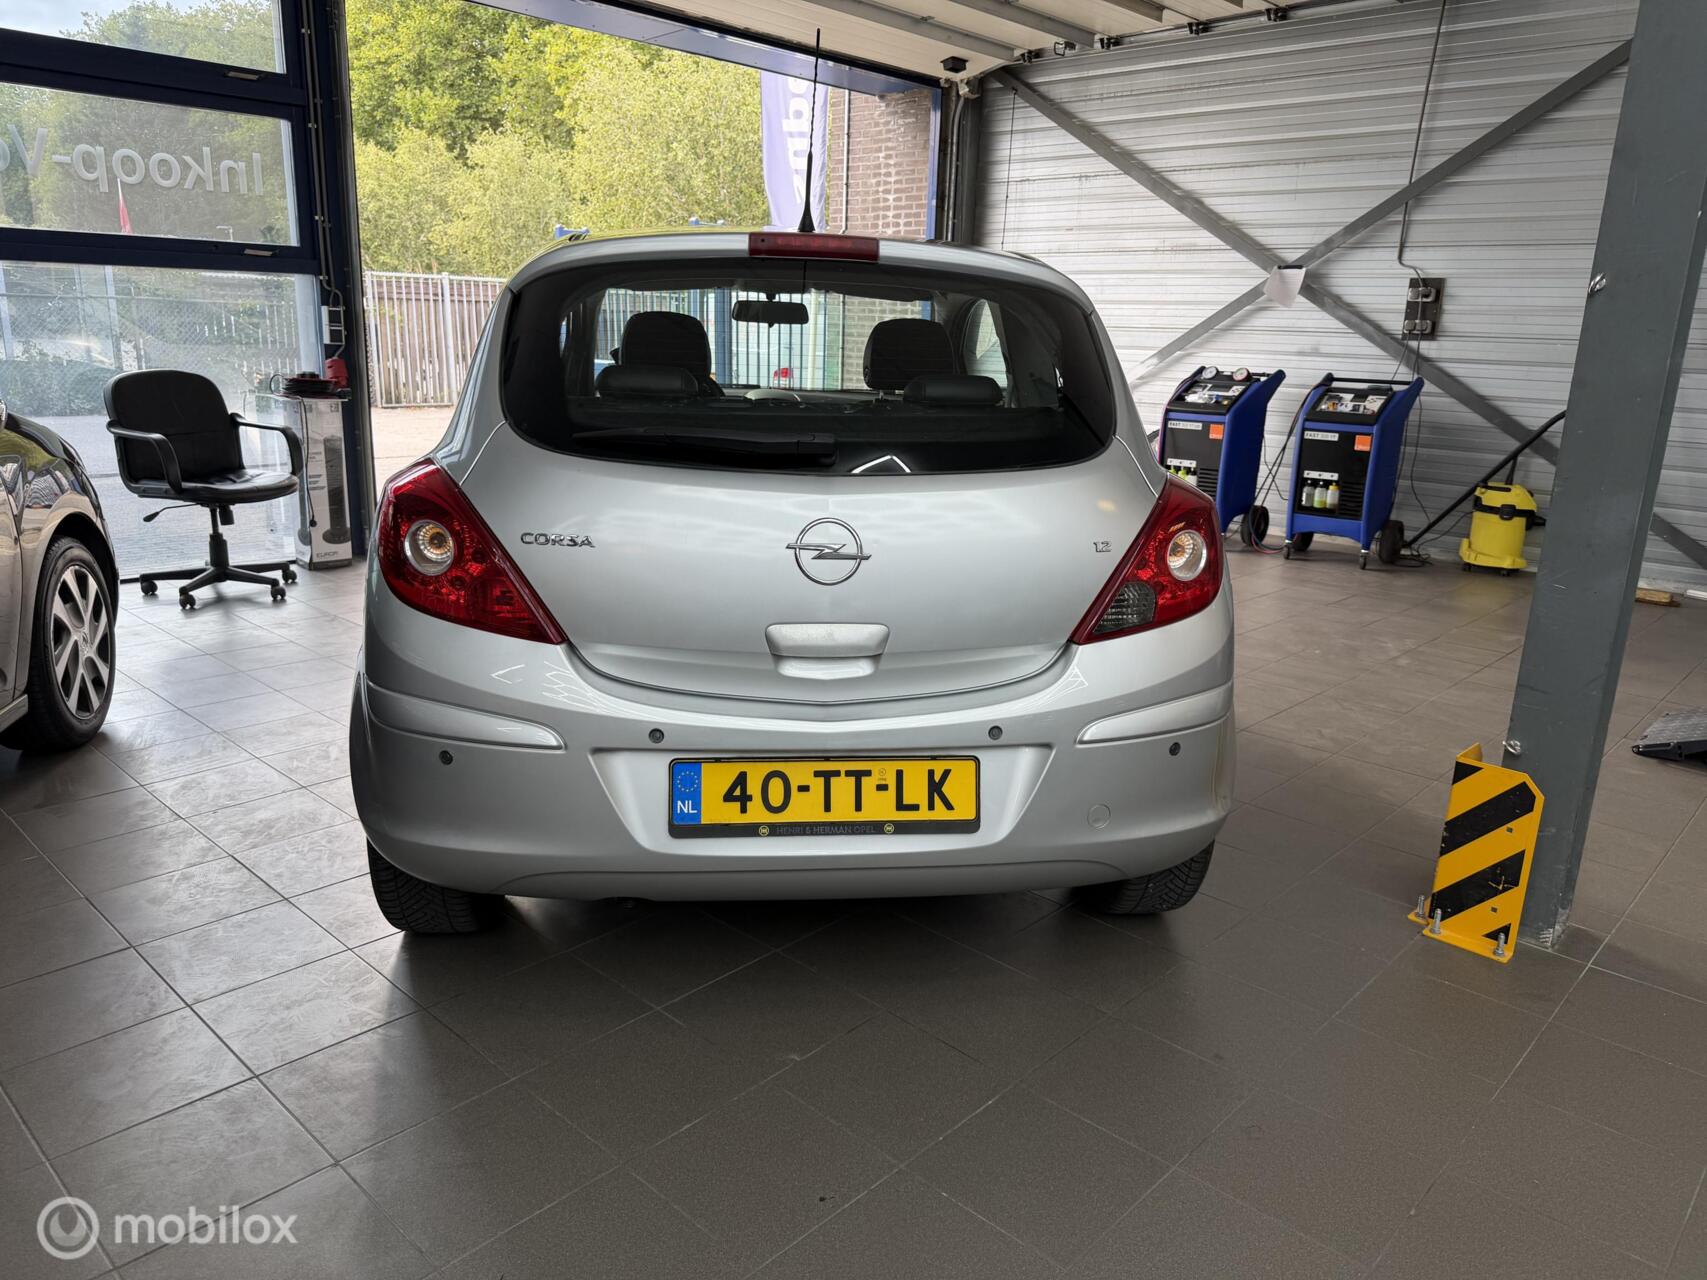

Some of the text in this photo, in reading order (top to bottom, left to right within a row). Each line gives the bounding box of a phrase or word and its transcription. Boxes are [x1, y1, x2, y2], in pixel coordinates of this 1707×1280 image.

[520, 532, 596, 548] CORSA
[722, 769, 955, 815] 40-TT-LK
[677, 800, 698, 814] NL
[776, 826, 803, 835] HENRI
[815, 825, 852, 835] HERMAN
[853, 825, 876, 834] OPEL
